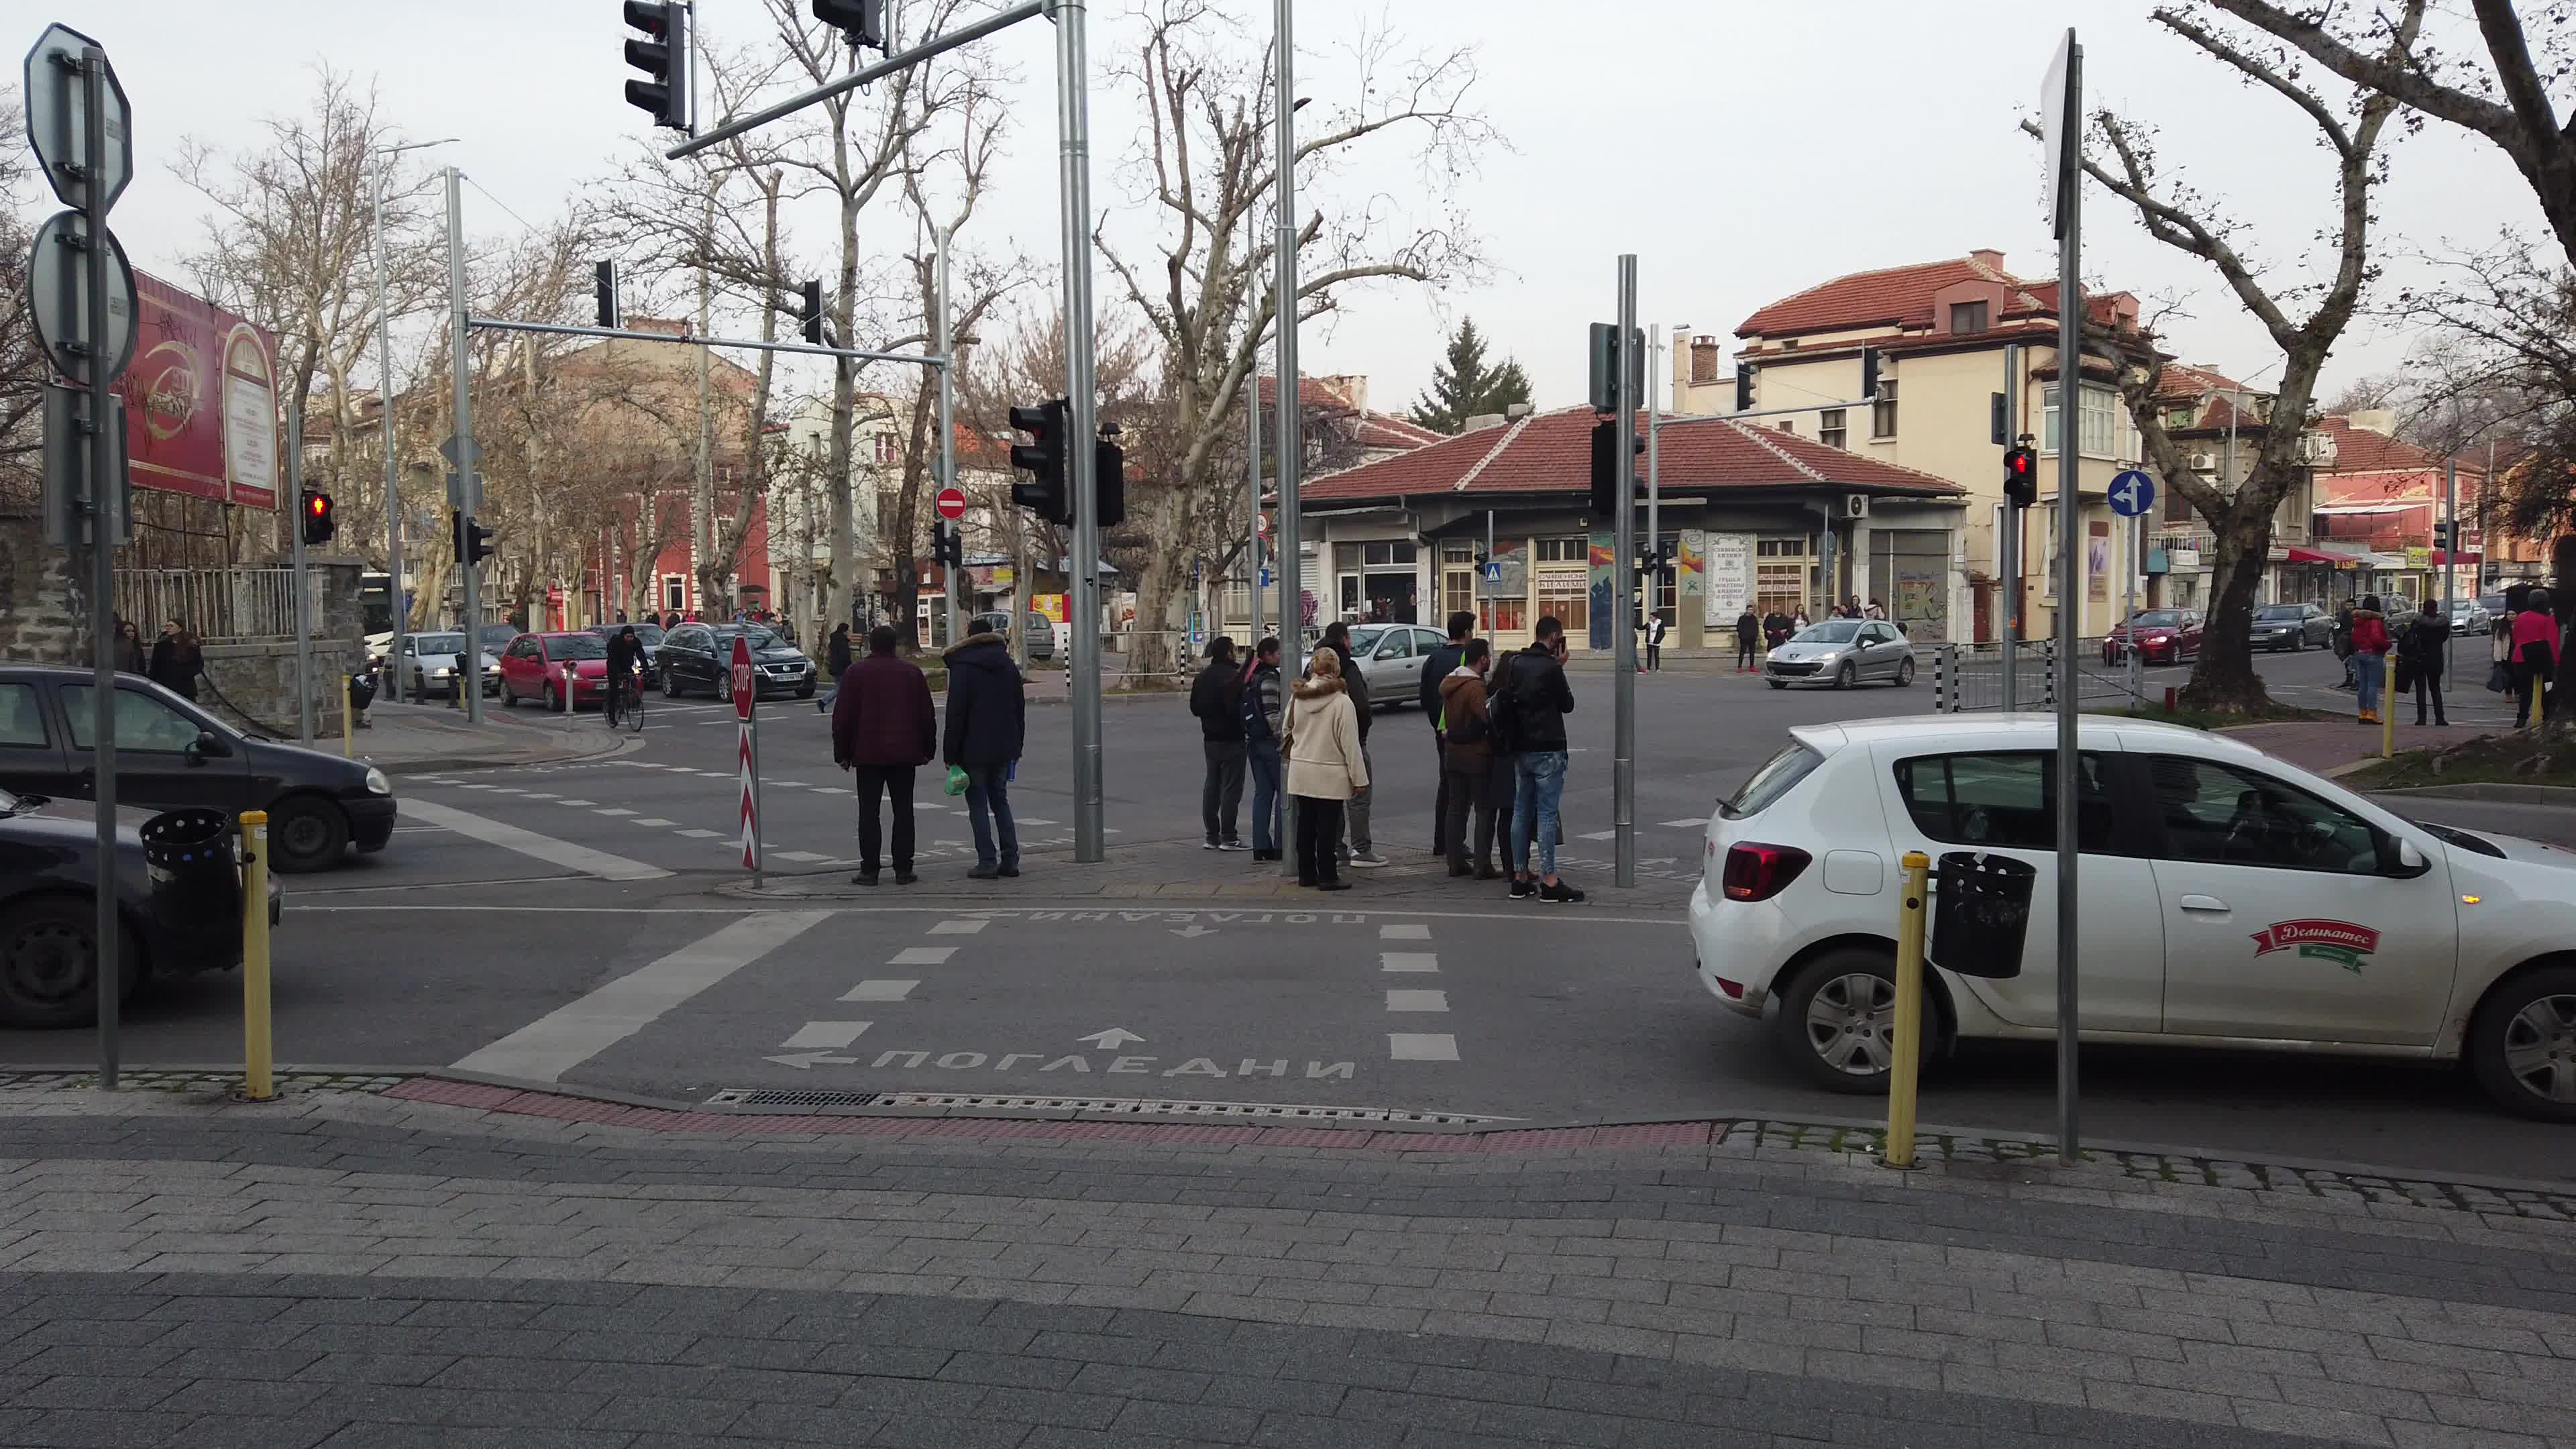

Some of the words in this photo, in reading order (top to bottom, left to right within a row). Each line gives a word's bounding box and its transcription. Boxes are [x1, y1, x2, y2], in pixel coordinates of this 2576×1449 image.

[733, 663, 750, 692] STOP
[1027, 910, 1366, 924] ПОГЛЕДНИ
[2282, 924, 2370, 944] Деликатес
[871, 1050, 1356, 1079] ПОГЛЕДНИ
